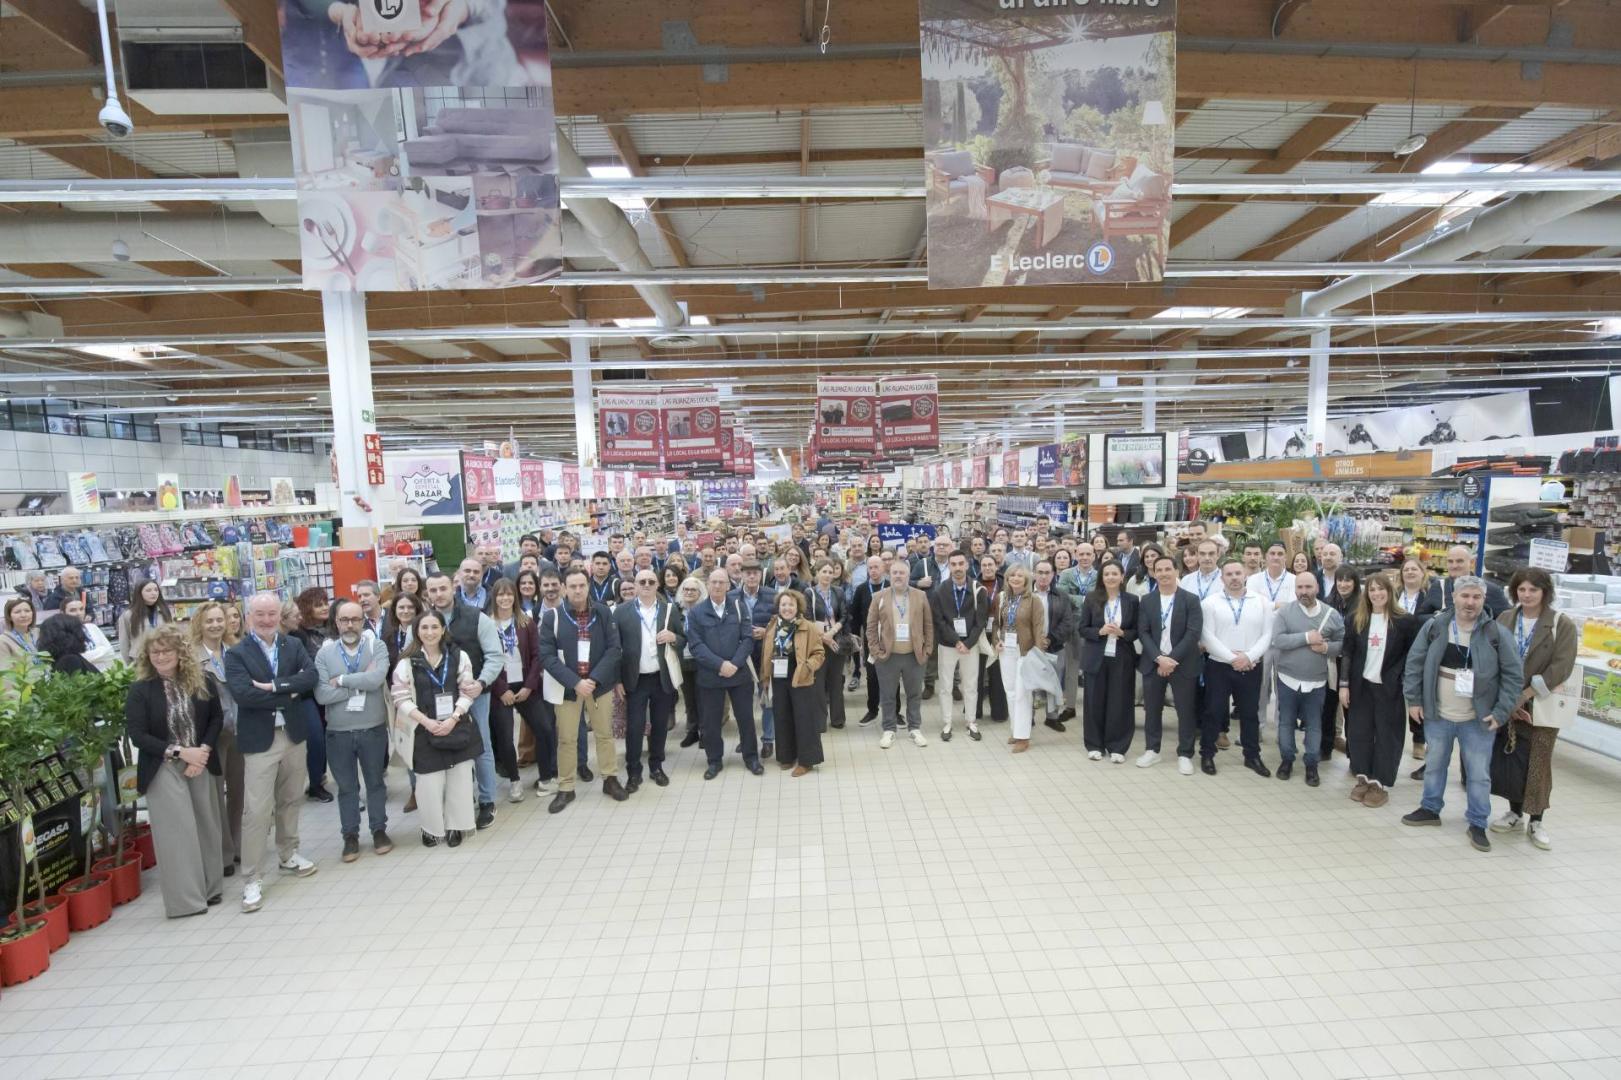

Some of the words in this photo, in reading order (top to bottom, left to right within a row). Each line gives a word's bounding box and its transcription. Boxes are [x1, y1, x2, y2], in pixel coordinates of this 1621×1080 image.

[1335, 467, 1364, 475] ANIMALES
[414, 490, 442, 498] BAZAR
[34, 821, 70, 846] EGASA
